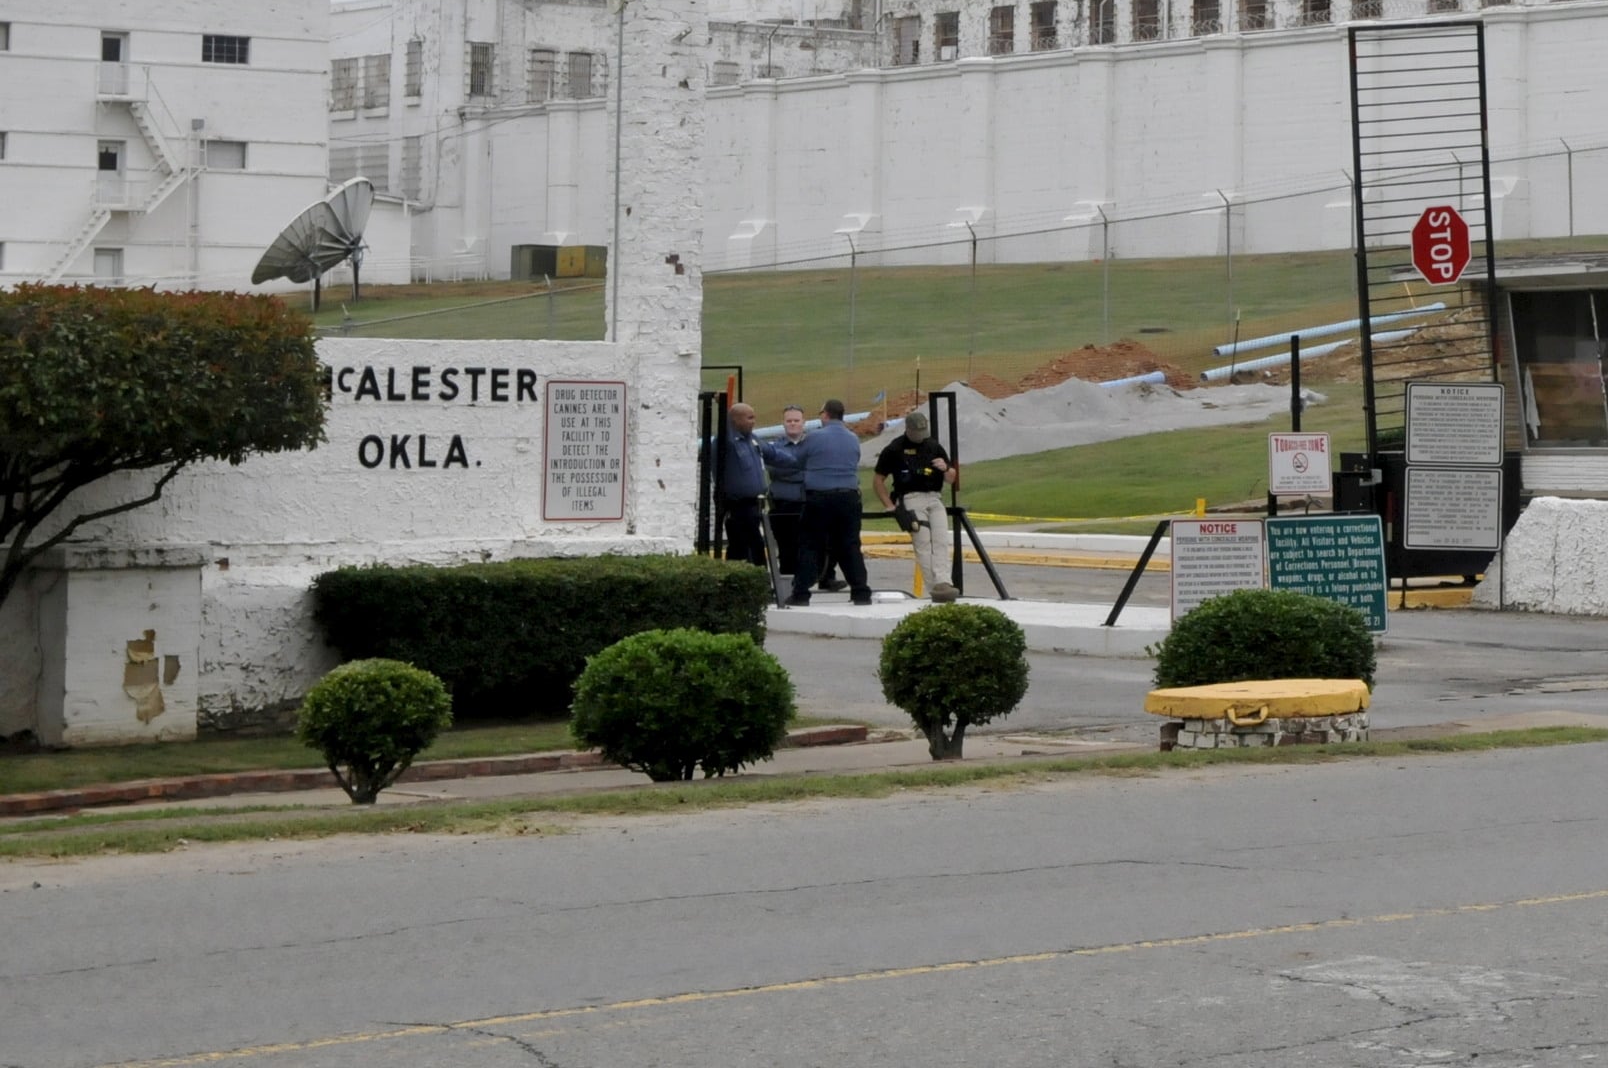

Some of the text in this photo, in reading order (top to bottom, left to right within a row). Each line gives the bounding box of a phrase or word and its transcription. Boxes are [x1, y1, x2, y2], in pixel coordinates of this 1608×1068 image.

[1429, 211, 1453, 279] STOP
[555, 389, 617, 400] DRUG DETECTOR
[554, 403, 618, 414] CANINES ARE IN
[561, 417, 611, 428] USE AT THIS
[562, 431, 610, 442] FACILITY TO
[358, 434, 482, 469] OKLA.
[562, 445, 608, 456] DETECT THE
[550, 459, 620, 469] INTRODUCTION OR
[552, 472, 618, 483] THE POSSESSION
[562, 486, 606, 498] OF ILLEGAL
[572, 500, 594, 511] ITEMS
[1200, 524, 1237, 533] NOTICE
[1271, 526, 1280, 535] You
[1310, 526, 1334, 536] entering
[1343, 524, 1378, 532] correctional
[1302, 536, 1310, 546] All
[1312, 536, 1335, 546] Visitors
[1338, 536, 1348, 545] and
[1351, 535, 1374, 544] Vehicles
[1270, 546, 1380, 561] are subject to search by Department
[1276, 562, 1282, 571] of
[1284, 561, 1318, 570] Corrections
[1338, 572, 1358, 580] alcohol
[1360, 572, 1368, 580] on
[1371, 570, 1376, 580] to
[1352, 582, 1382, 593] punishable
